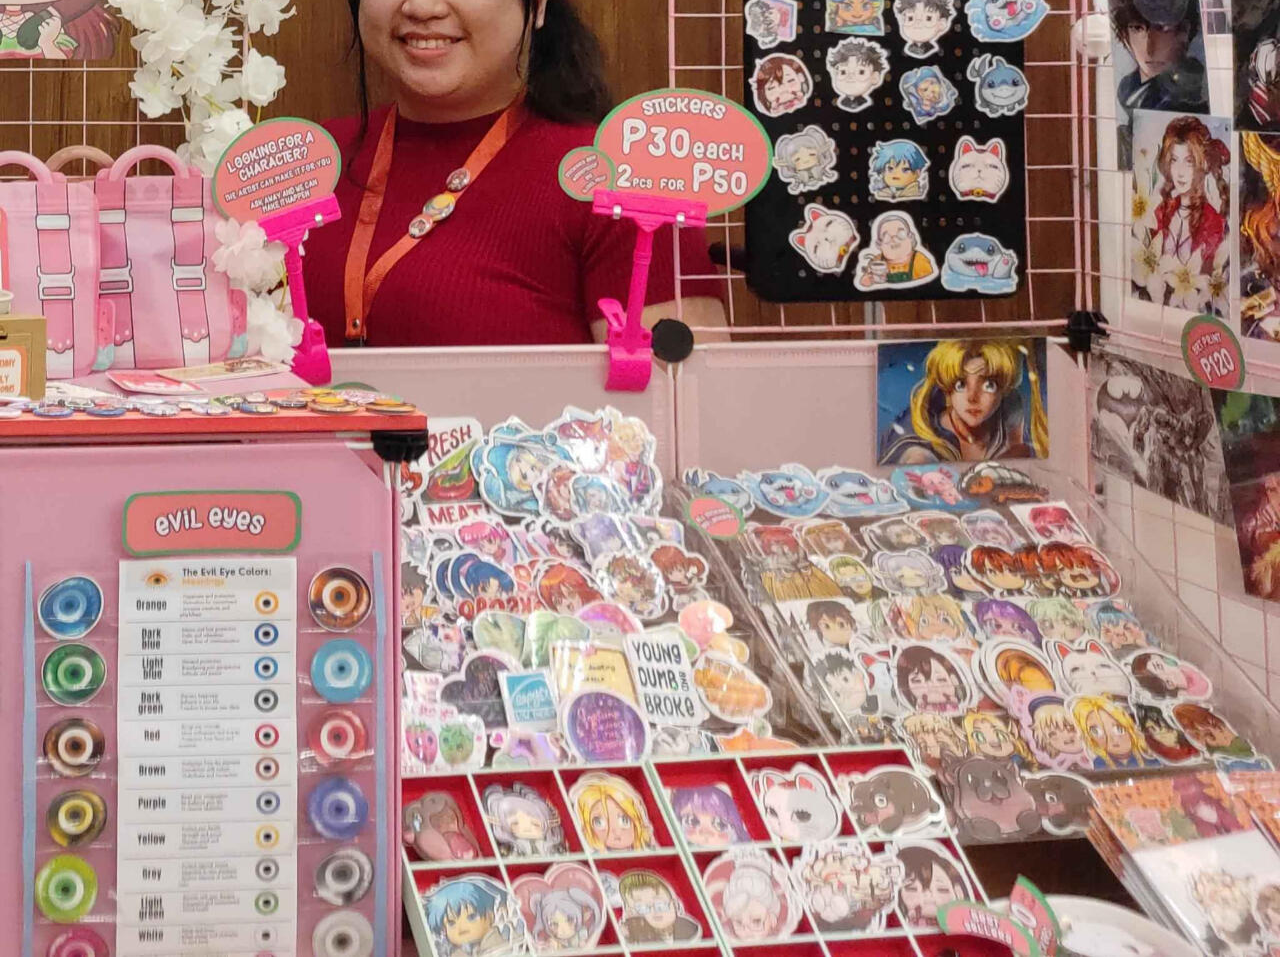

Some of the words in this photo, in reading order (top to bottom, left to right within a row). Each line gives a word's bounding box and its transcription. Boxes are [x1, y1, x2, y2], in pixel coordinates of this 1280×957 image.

[226, 141, 277, 173] LOOKING
[278, 133, 303, 150] FOR
[306, 130, 314, 143] A
[239, 146, 308, 181] CHARACTER?
[238, 184, 260, 196] ARTIST
[260, 178, 274, 189] CAN
[275, 171, 294, 184] MAKE
[301, 163, 315, 174] FOR
[316, 157, 331, 168] YOU
[659, 178, 685, 191] FOR
[692, 162, 748, 195] P50
[282, 187, 295, 197] AND
[305, 179, 318, 190] CAN
[286, 189, 310, 204] HAPPEN
[1200, 347, 1235, 382] P120
[426, 424, 472, 467] RESH
[182, 568, 198, 577] The
[201, 568, 217, 577] Evil
[220, 568, 235, 579] Eye
[136, 599, 167, 611] Orange
[141, 628, 161, 640] Dark
[141, 640, 161, 650] blue
[142, 657, 163, 670] Light
[143, 669, 162, 680] blue
[638, 666, 679, 691] DUMB
[141, 691, 161, 703] Dark
[138, 704, 163, 715] green
[144, 730, 160, 741] Red
[138, 764, 166, 777] Brown
[138, 797, 166, 810] Purple
[137, 832, 166, 846] Yellow
[138, 928, 164, 942] White
